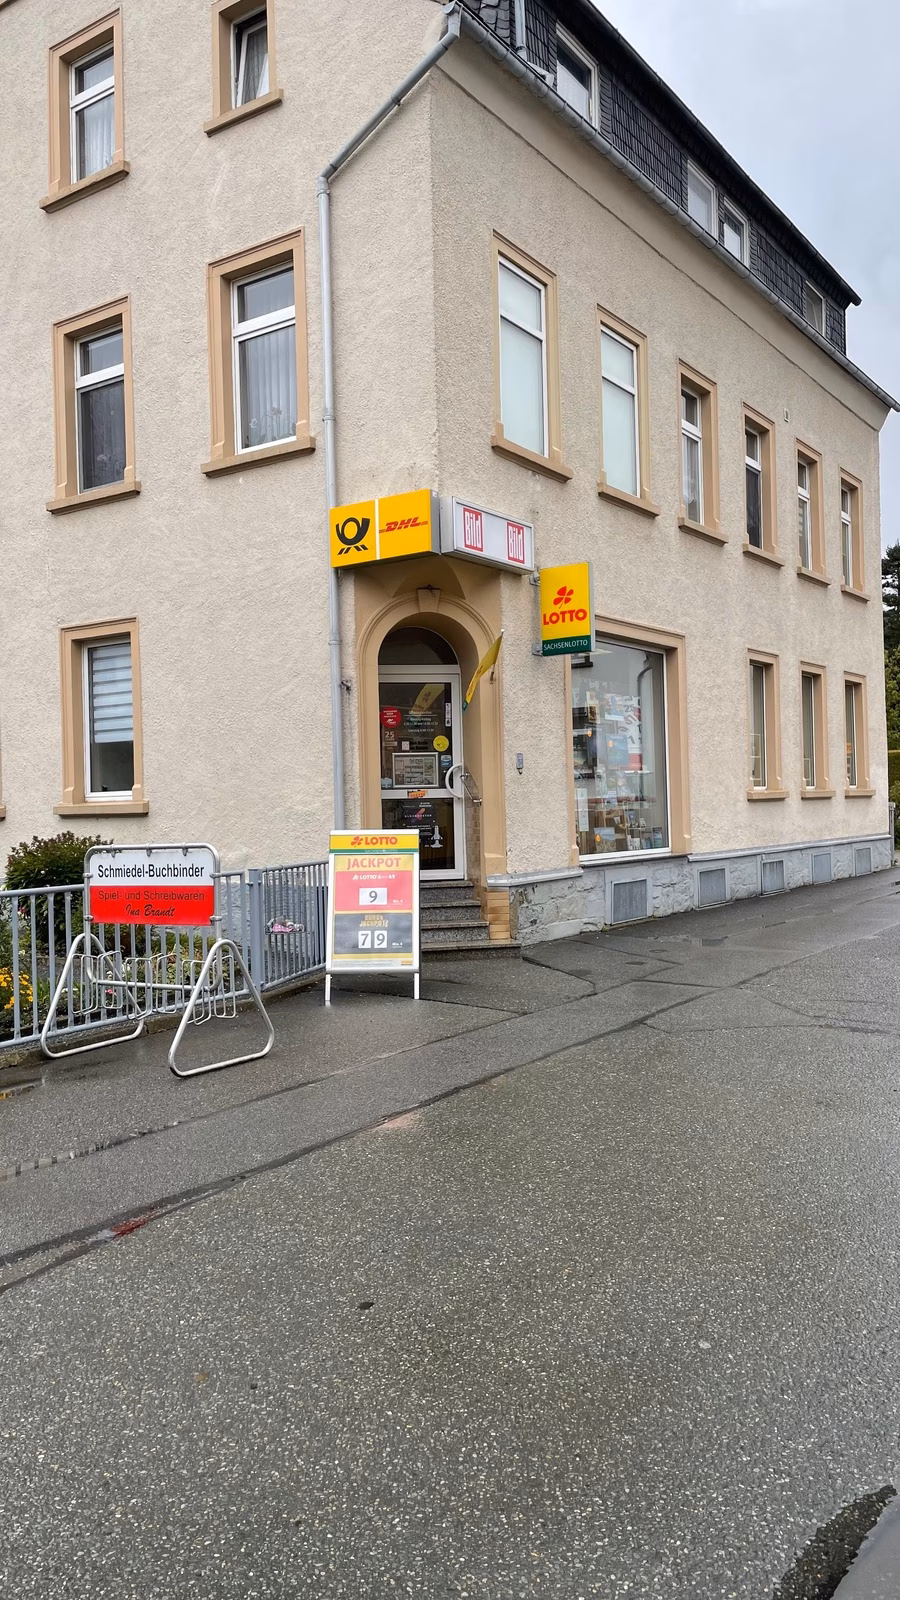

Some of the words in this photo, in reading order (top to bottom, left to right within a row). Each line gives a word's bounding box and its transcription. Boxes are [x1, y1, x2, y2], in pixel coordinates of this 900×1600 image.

[385, 516, 421, 532] DHL
[464, 509, 482, 550] Bild
[508, 526, 524, 563] Bild
[543, 608, 587, 626] LOTTO
[544, 640, 588, 650] SACHSENLOTTO
[364, 836, 398, 845] LOTTO
[346, 858, 401, 870] JACKPOT
[98, 864, 204, 878] Schmiedel-Buchbinder
[98, 890, 122, 901] Spiel-
[125, 890, 140, 900] und
[144, 890, 205, 900] Schreibwaren
[369, 890, 378, 903] 9
[125, 904, 140, 916] Ina
[144, 904, 176, 916] Brandt
